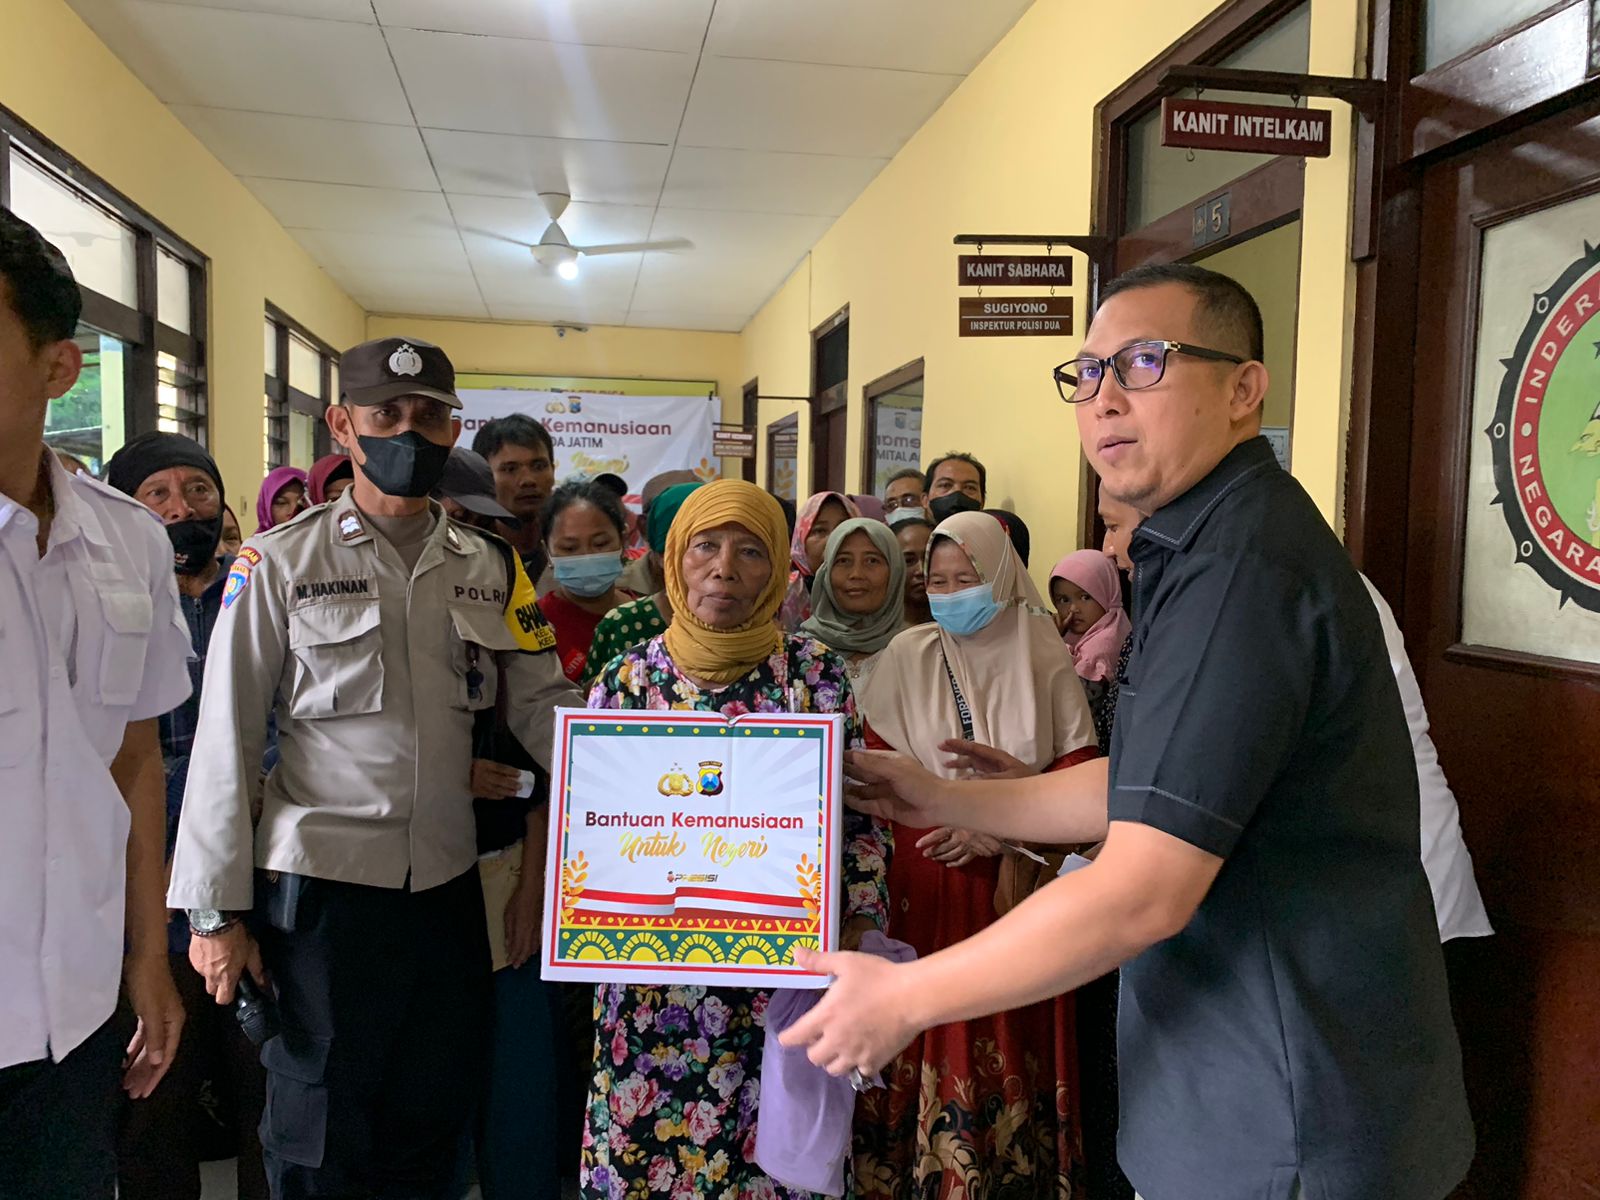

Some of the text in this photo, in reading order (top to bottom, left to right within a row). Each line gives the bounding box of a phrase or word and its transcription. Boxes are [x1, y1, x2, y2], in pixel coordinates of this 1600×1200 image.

[1173, 110, 1324, 142] KANIT INTELKAM
[1211, 202, 1222, 233] 5
[966, 263, 1065, 277] KANIT SABHARA
[983, 303, 1048, 313] SUGIYONO
[970, 321, 1061, 330] INSPEKTUR POLISI DUA
[1524, 293, 1600, 404] INDER
[541, 417, 672, 436] Kemanusiaan
[567, 438, 603, 448] JATIM
[1519, 454, 1600, 576] NEGARA
[296, 579, 368, 600] M.HAKINAN
[454, 586, 506, 604] POLRI
[585, 811, 804, 829] Bantuan Kemanusiaan
[618, 831, 768, 868] Untuk Negeri
